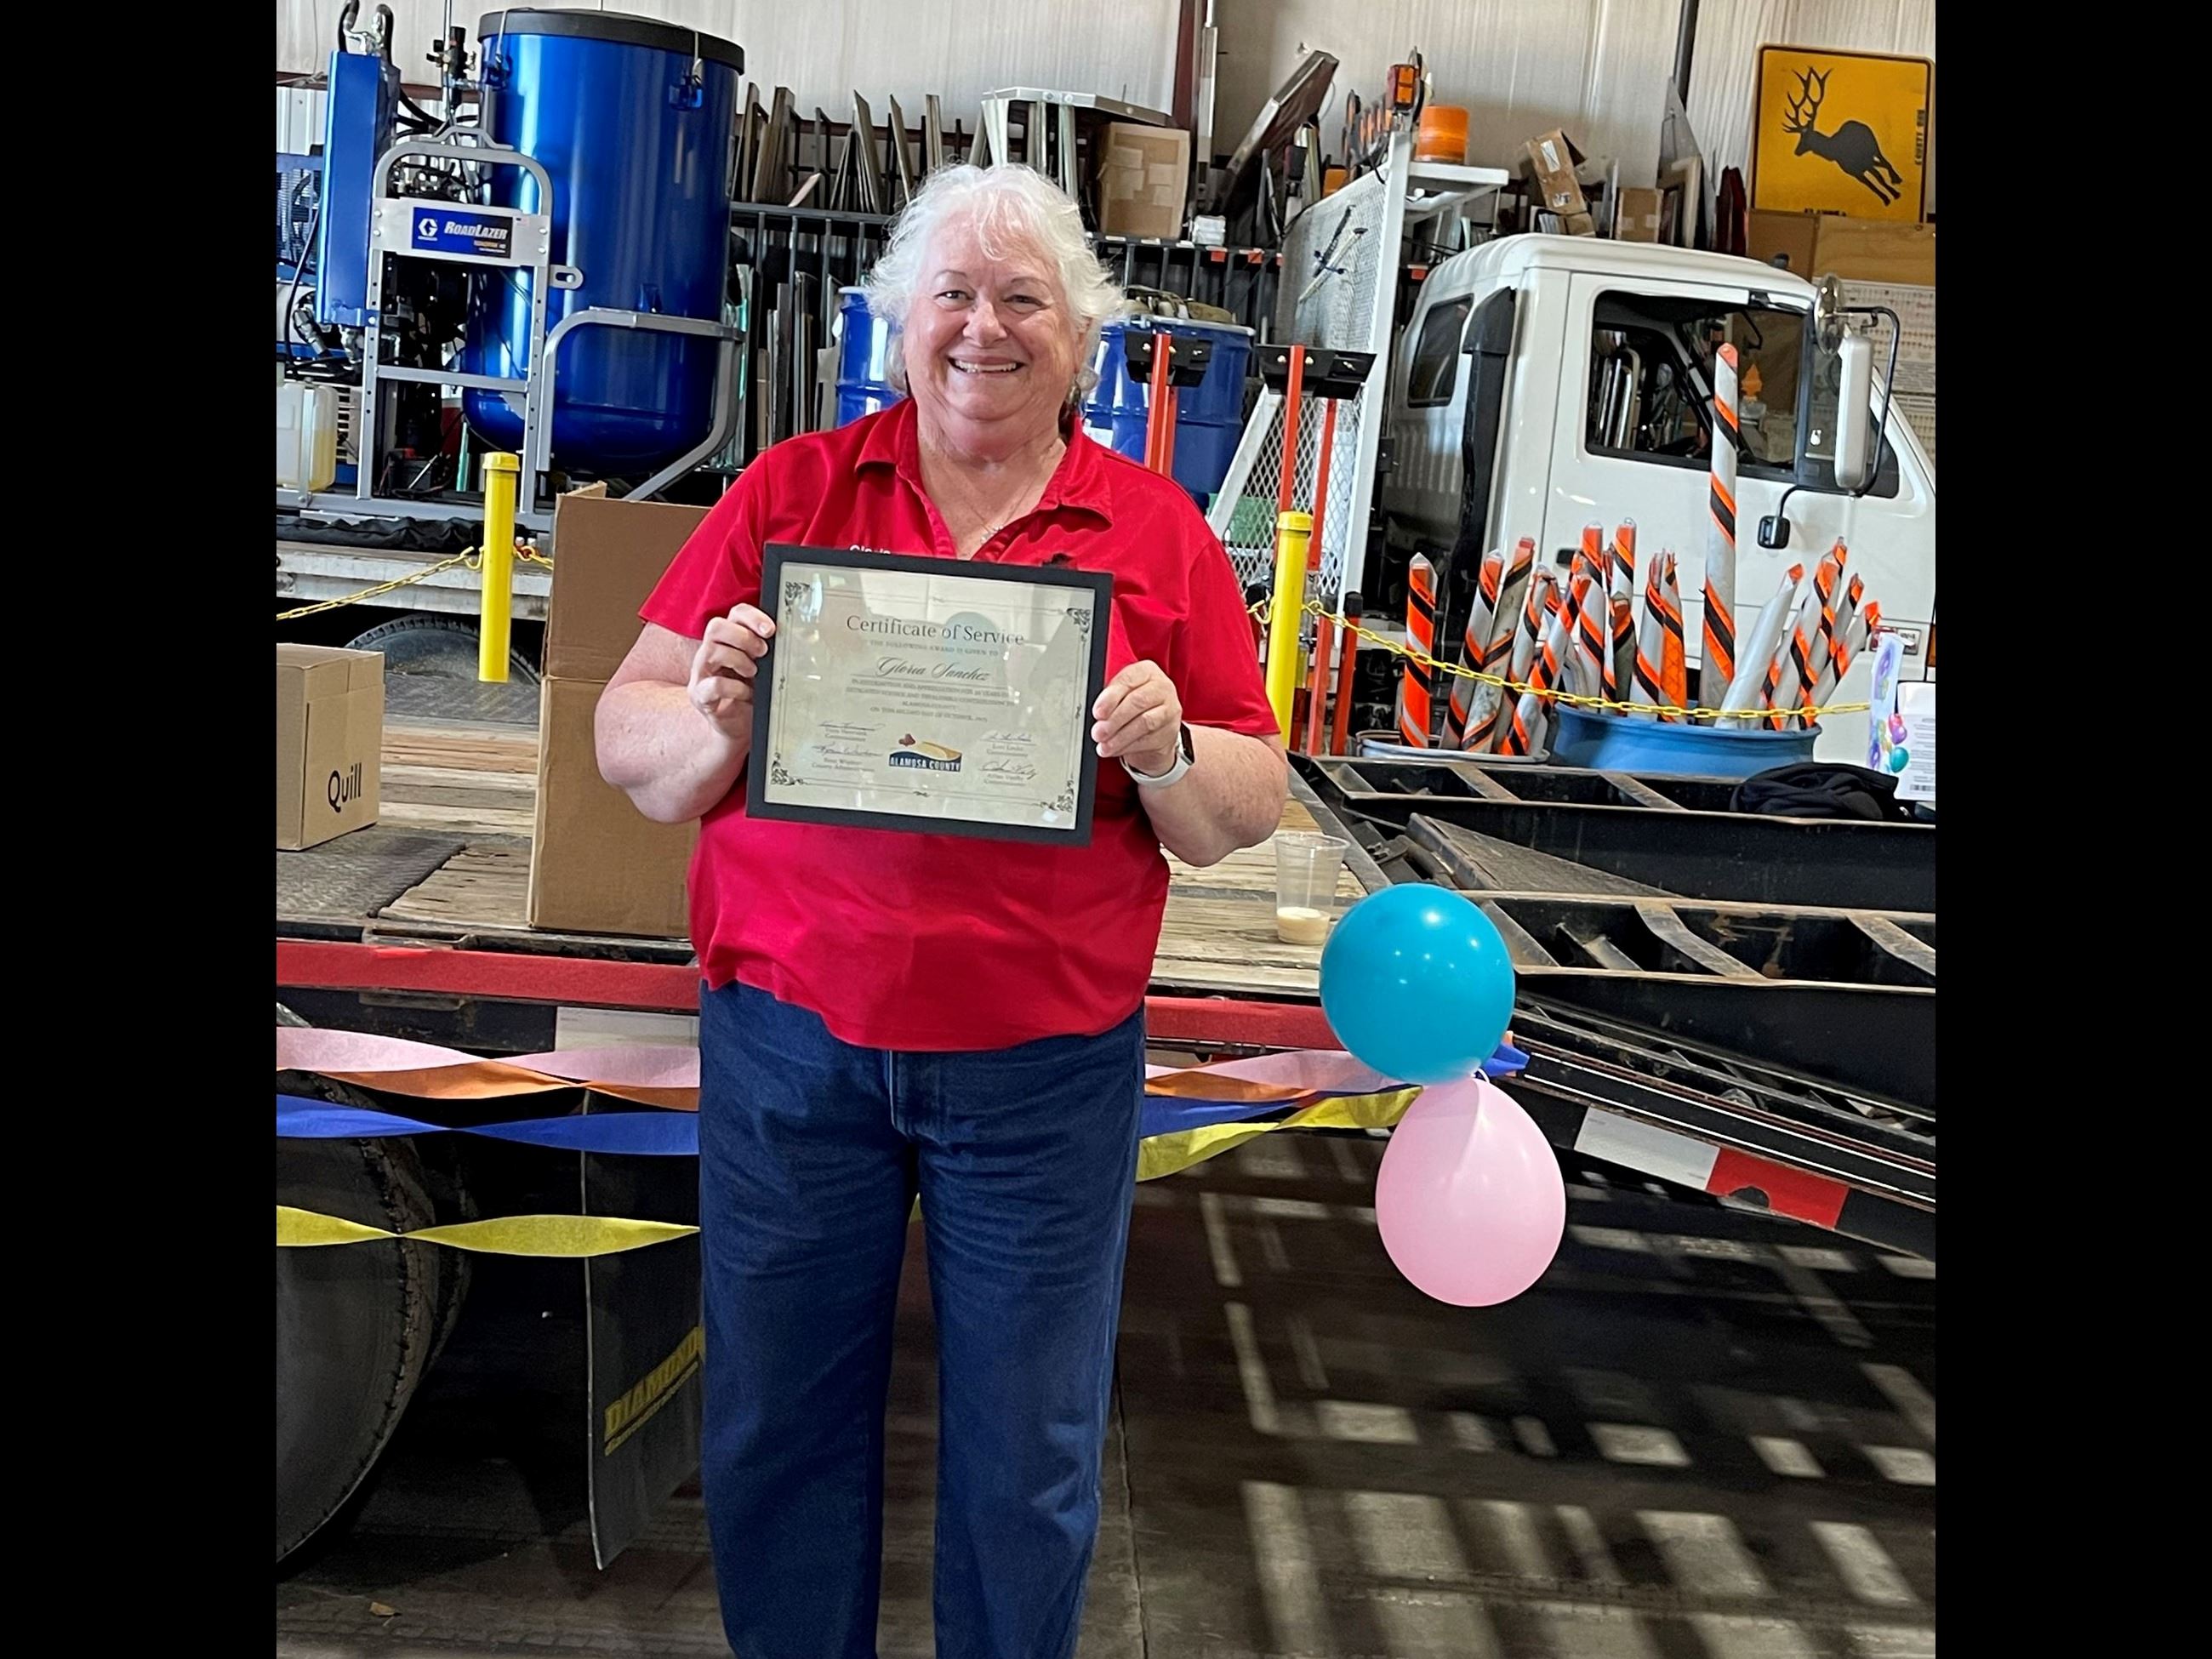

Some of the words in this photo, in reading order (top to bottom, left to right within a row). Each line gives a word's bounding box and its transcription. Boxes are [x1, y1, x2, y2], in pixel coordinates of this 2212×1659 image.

[847, 615, 936, 637] Certificate
[942, 624, 961, 639] of
[963, 626, 1023, 645] Service
[875, 657, 927, 677] Gloria
[932, 663, 992, 681] Sanchez
[890, 756, 926, 768] ALAMOSA
[929, 761, 961, 771] COUNTY
[328, 762, 362, 813] Quill
